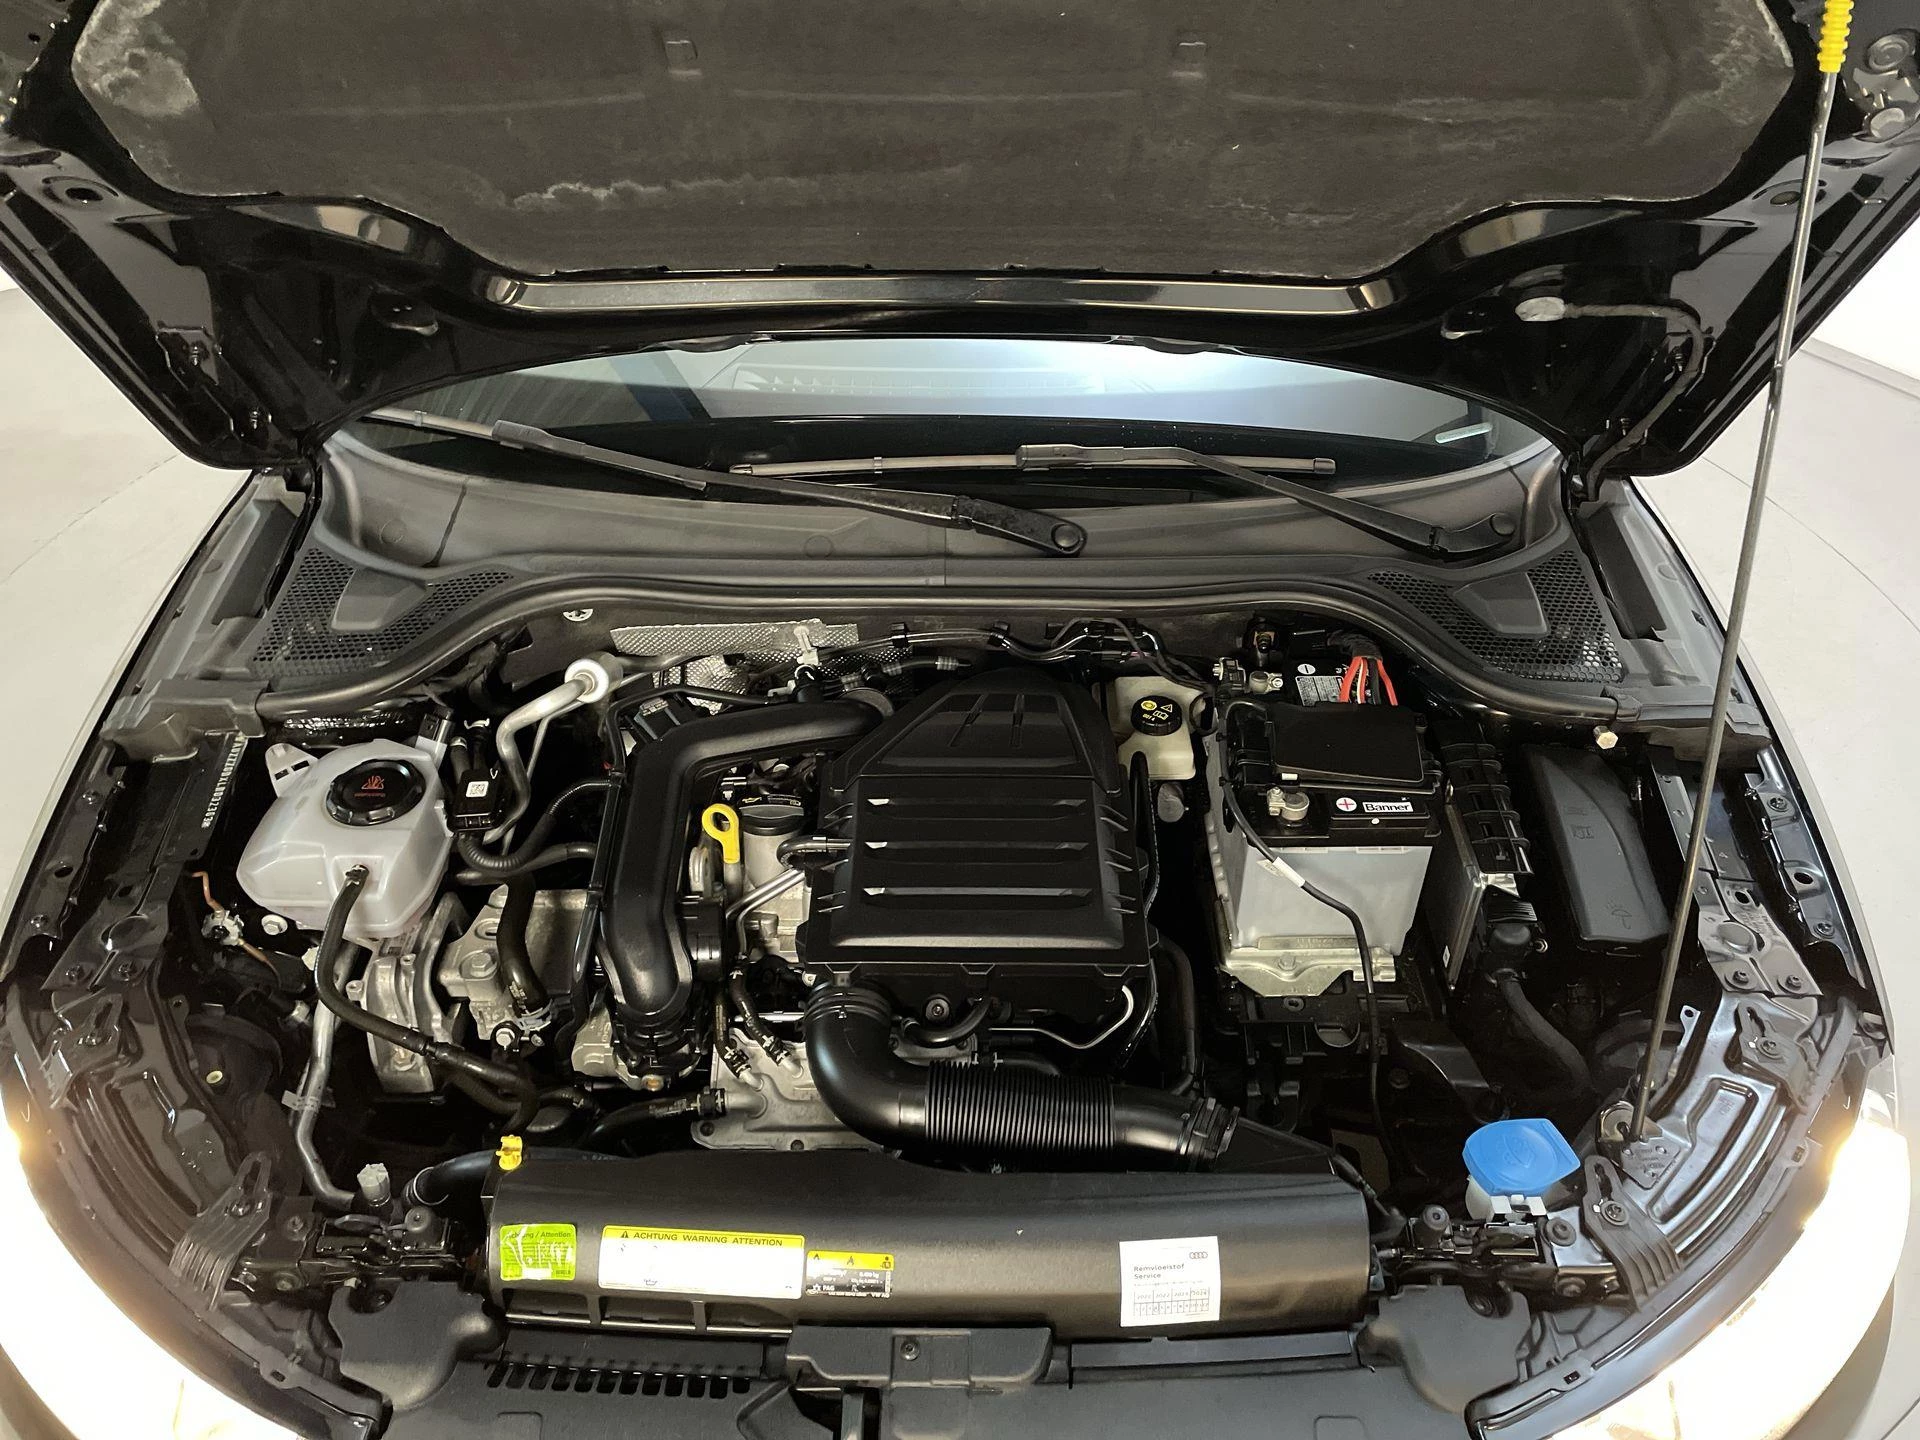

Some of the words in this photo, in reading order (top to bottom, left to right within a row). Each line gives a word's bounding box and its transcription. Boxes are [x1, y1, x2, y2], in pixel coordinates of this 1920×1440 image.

[1364, 803, 1411, 812] Banner
[541, 1230, 571, 1238] Attention
[633, 1232, 678, 1241] ACHTUNG
[682, 1233, 728, 1244] WARNING
[732, 1237, 783, 1246] ATTENTION
[1133, 1263, 1185, 1272] Remvloeistof
